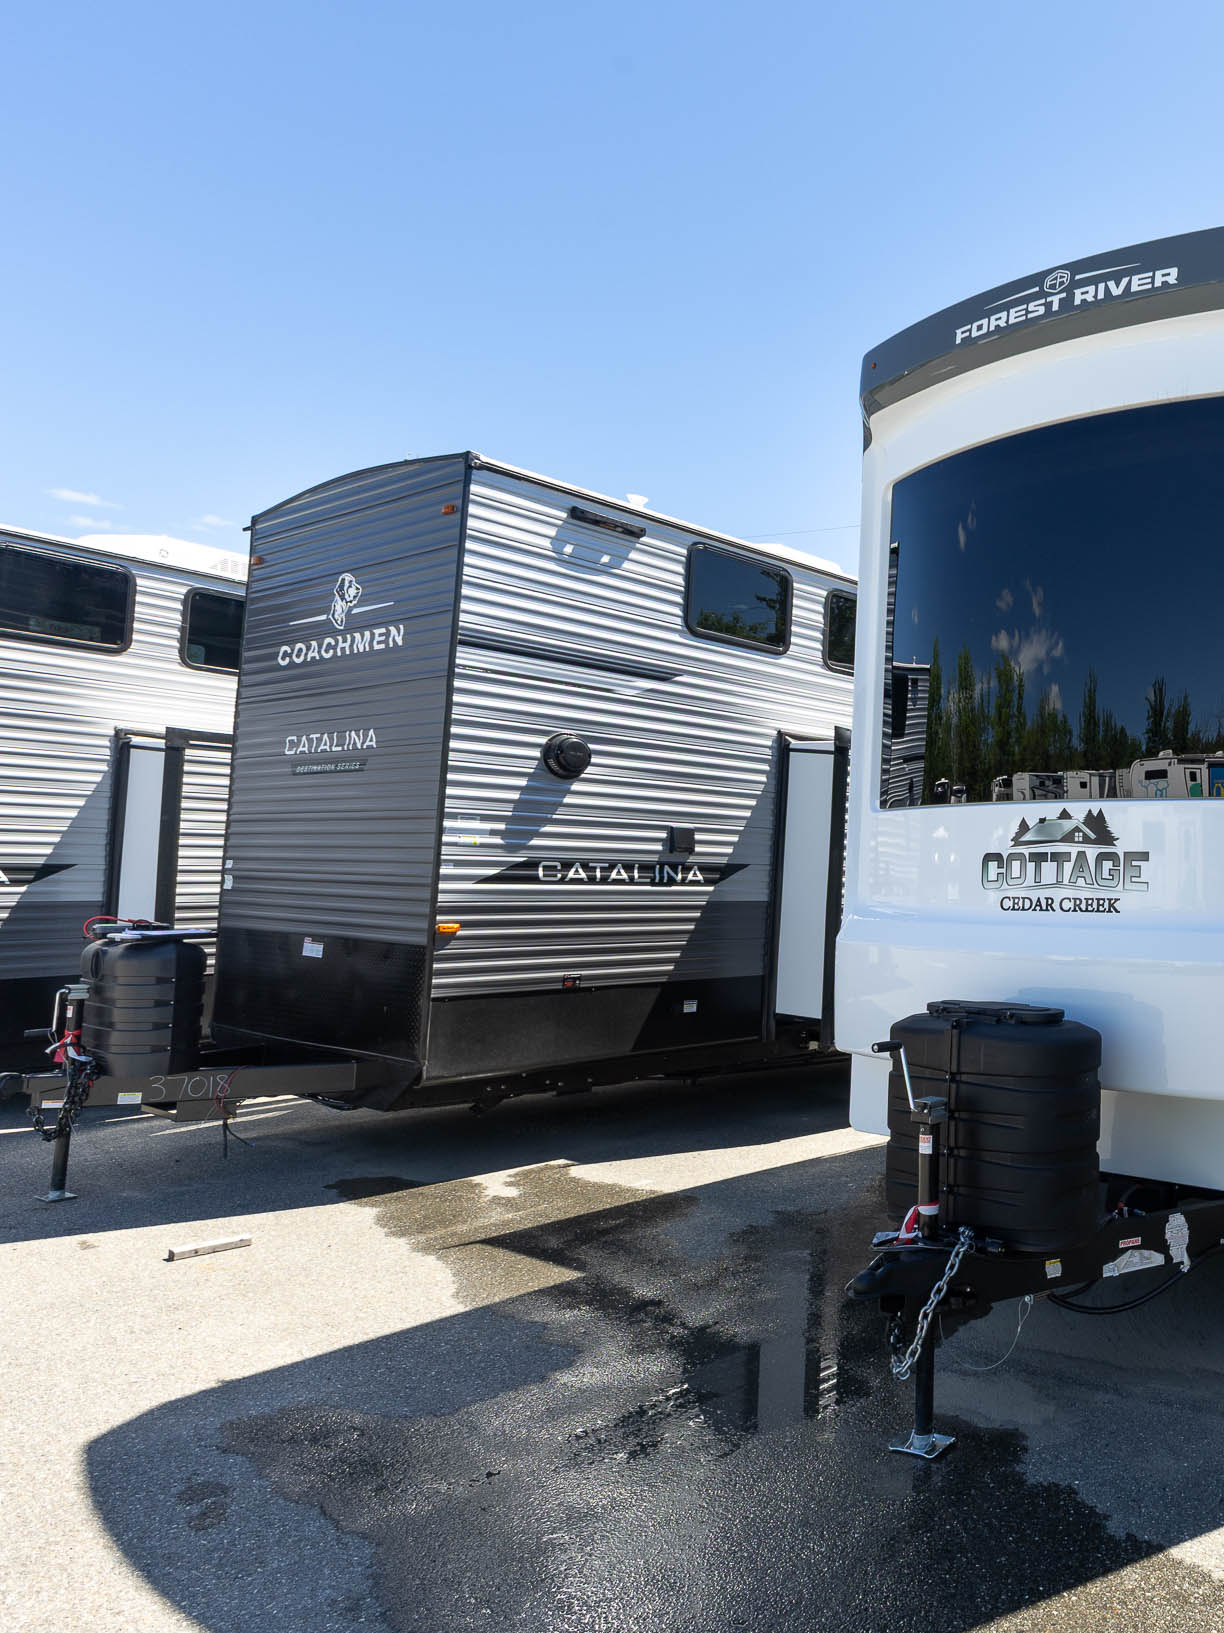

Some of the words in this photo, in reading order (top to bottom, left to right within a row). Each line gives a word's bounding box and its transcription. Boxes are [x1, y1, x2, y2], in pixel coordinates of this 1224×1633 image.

[955, 293, 1067, 345] FOREST
[1073, 267, 1179, 306] RIVER
[277, 624, 404, 666] COACHMEN
[284, 728, 377, 755] CATALINA
[336, 762, 361, 771] SERIES
[538, 861, 705, 883] CATALINA
[981, 850, 1150, 891] COTTAGE
[999, 896, 1056, 912] CEDAR
[1059, 897, 1121, 914] CREEK
[149, 1074, 231, 1101] 37018
